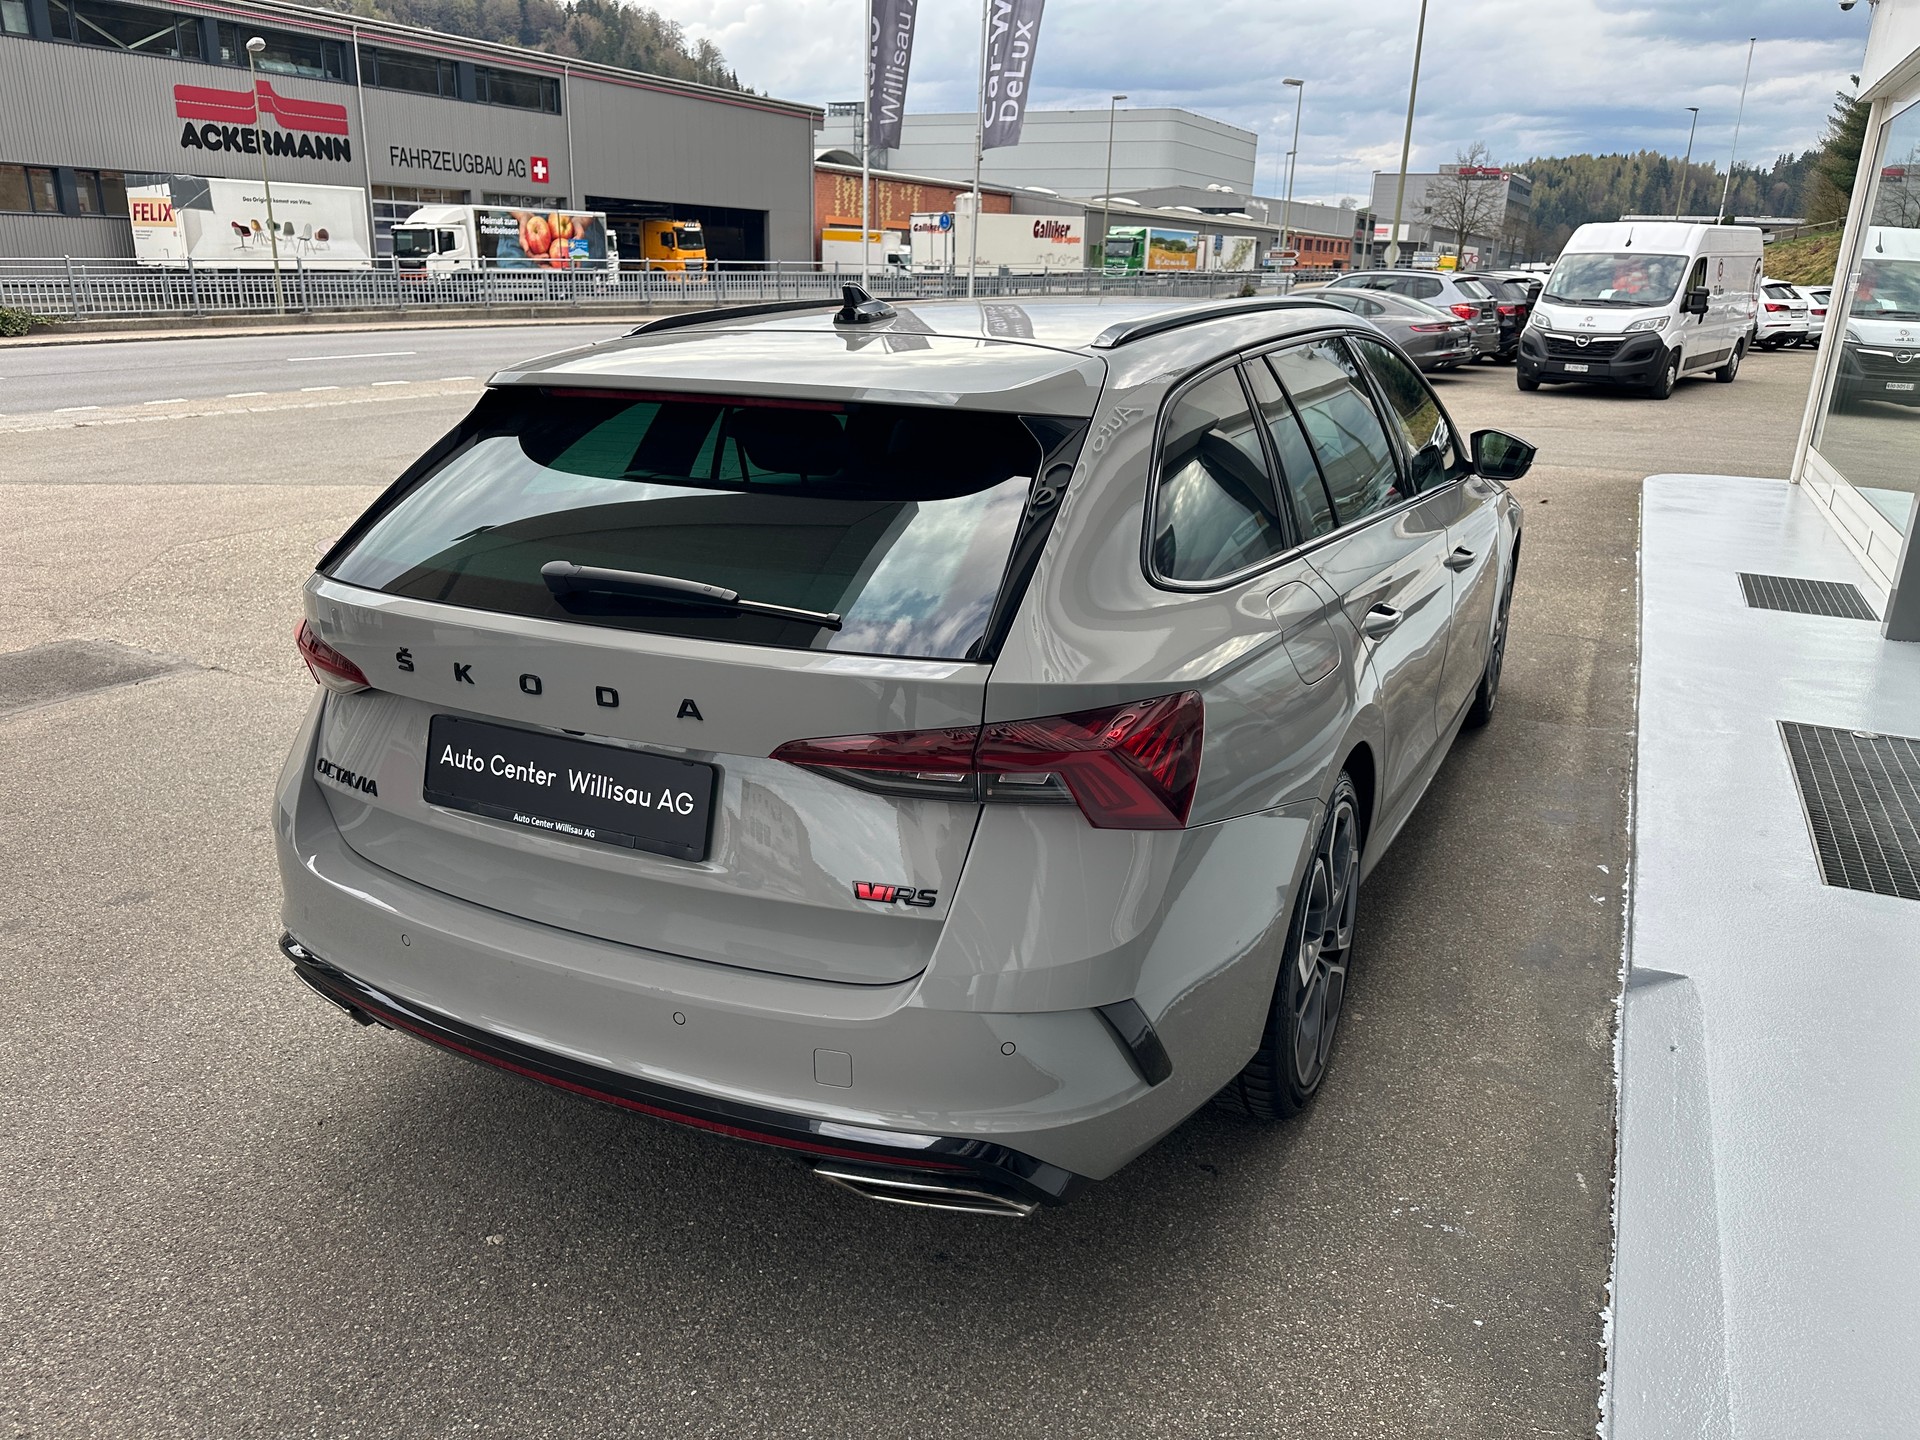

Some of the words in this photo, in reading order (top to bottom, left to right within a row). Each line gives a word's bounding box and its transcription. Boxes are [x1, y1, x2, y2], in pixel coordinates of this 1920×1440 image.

[880, 12, 911, 124] Willisau
[180, 121, 351, 163] ACKERMANN
[389, 146, 503, 177] FAHRZEUGBAU
[506, 158, 526, 178] AG
[133, 203, 173, 222] FELIX
[1033, 220, 1071, 239] Galliker
[395, 646, 703, 721] ŠKODA
[317, 757, 378, 798] OCTAVIA
[440, 744, 485, 773] Auto
[490, 754, 556, 787] Center
[568, 768, 651, 807] Willisau
[657, 788, 695, 815] AG
[513, 813, 530, 824] Auto
[531, 817, 554, 830] Center
[555, 821, 584, 836] Willisau
[584, 828, 595, 838] AG
